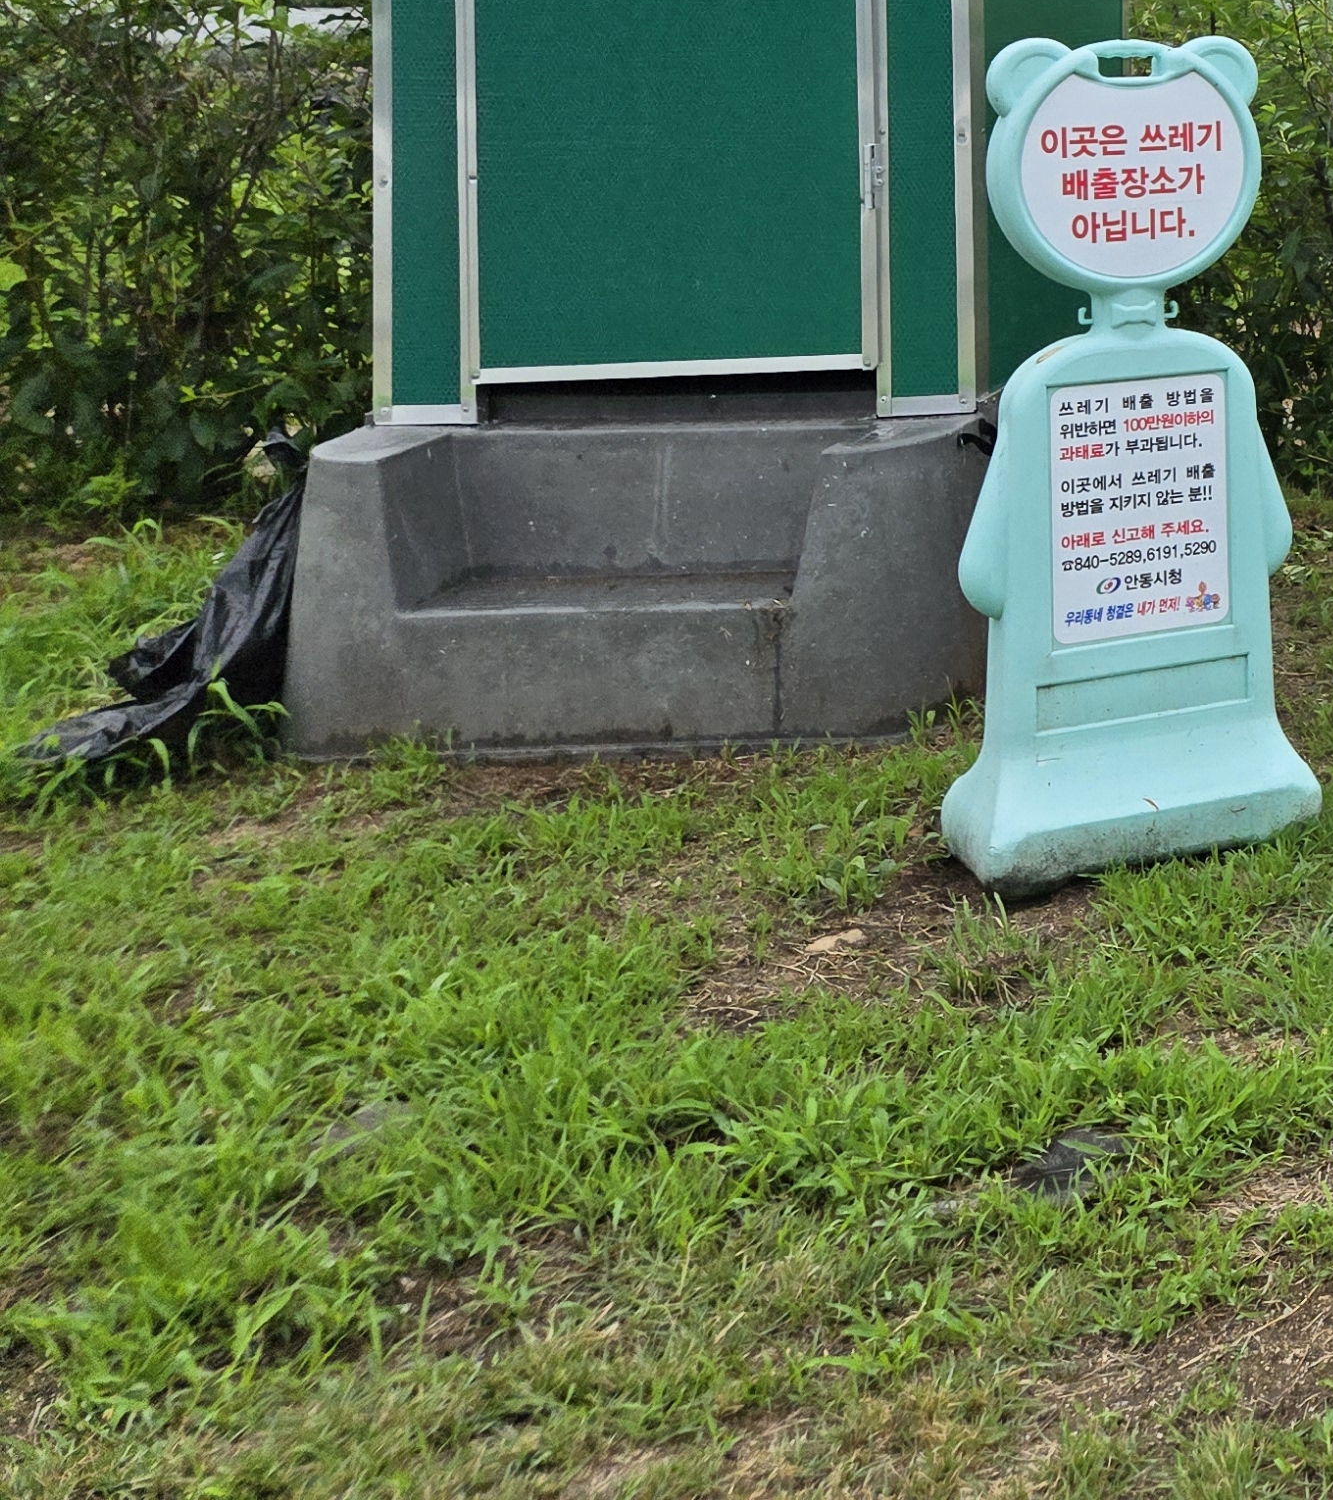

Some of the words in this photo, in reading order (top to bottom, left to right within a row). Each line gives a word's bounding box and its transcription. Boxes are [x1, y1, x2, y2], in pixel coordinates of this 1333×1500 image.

[1040, 124, 1128, 159] 이곳은
[1138, 121, 1222, 152] 쓰레기
[1061, 163, 1205, 201] 배출장소가
[1070, 206, 1196, 243] 아닙니다.
[1058, 397, 1109, 417] 쓰레기
[1122, 393, 1154, 411] 배출
[1166, 388, 1215, 407] 방법을
[1059, 420, 1117, 440] 위반하면
[1123, 409, 1215, 433] 100만원이하의
[1059, 441, 1120, 462] 과태료가
[1125, 433, 1203, 455] 부과됩니다.
[1061, 474, 1122, 495] 이곳에서
[1131, 467, 1178, 486] 쓰레기
[1186, 463, 1216, 480] 배출
[1061, 498, 1104, 518] 방법을
[1109, 492, 1151, 511] 지키지
[1156, 489, 1184, 506] 않는
[1188, 485, 1213, 502] 분!!
[1061, 530, 1105, 551] 아래로
[1112, 524, 1155, 544] 신고해
[1160, 518, 1209, 538] 주세요.
[1124, 568, 1183, 591] 안동시청
[1065, 606, 1104, 627] 우리동네
[1106, 602, 1135, 622] 청결은
[1137, 599, 1156, 616] 내가
[1159, 596, 1181, 612] 먼저!
